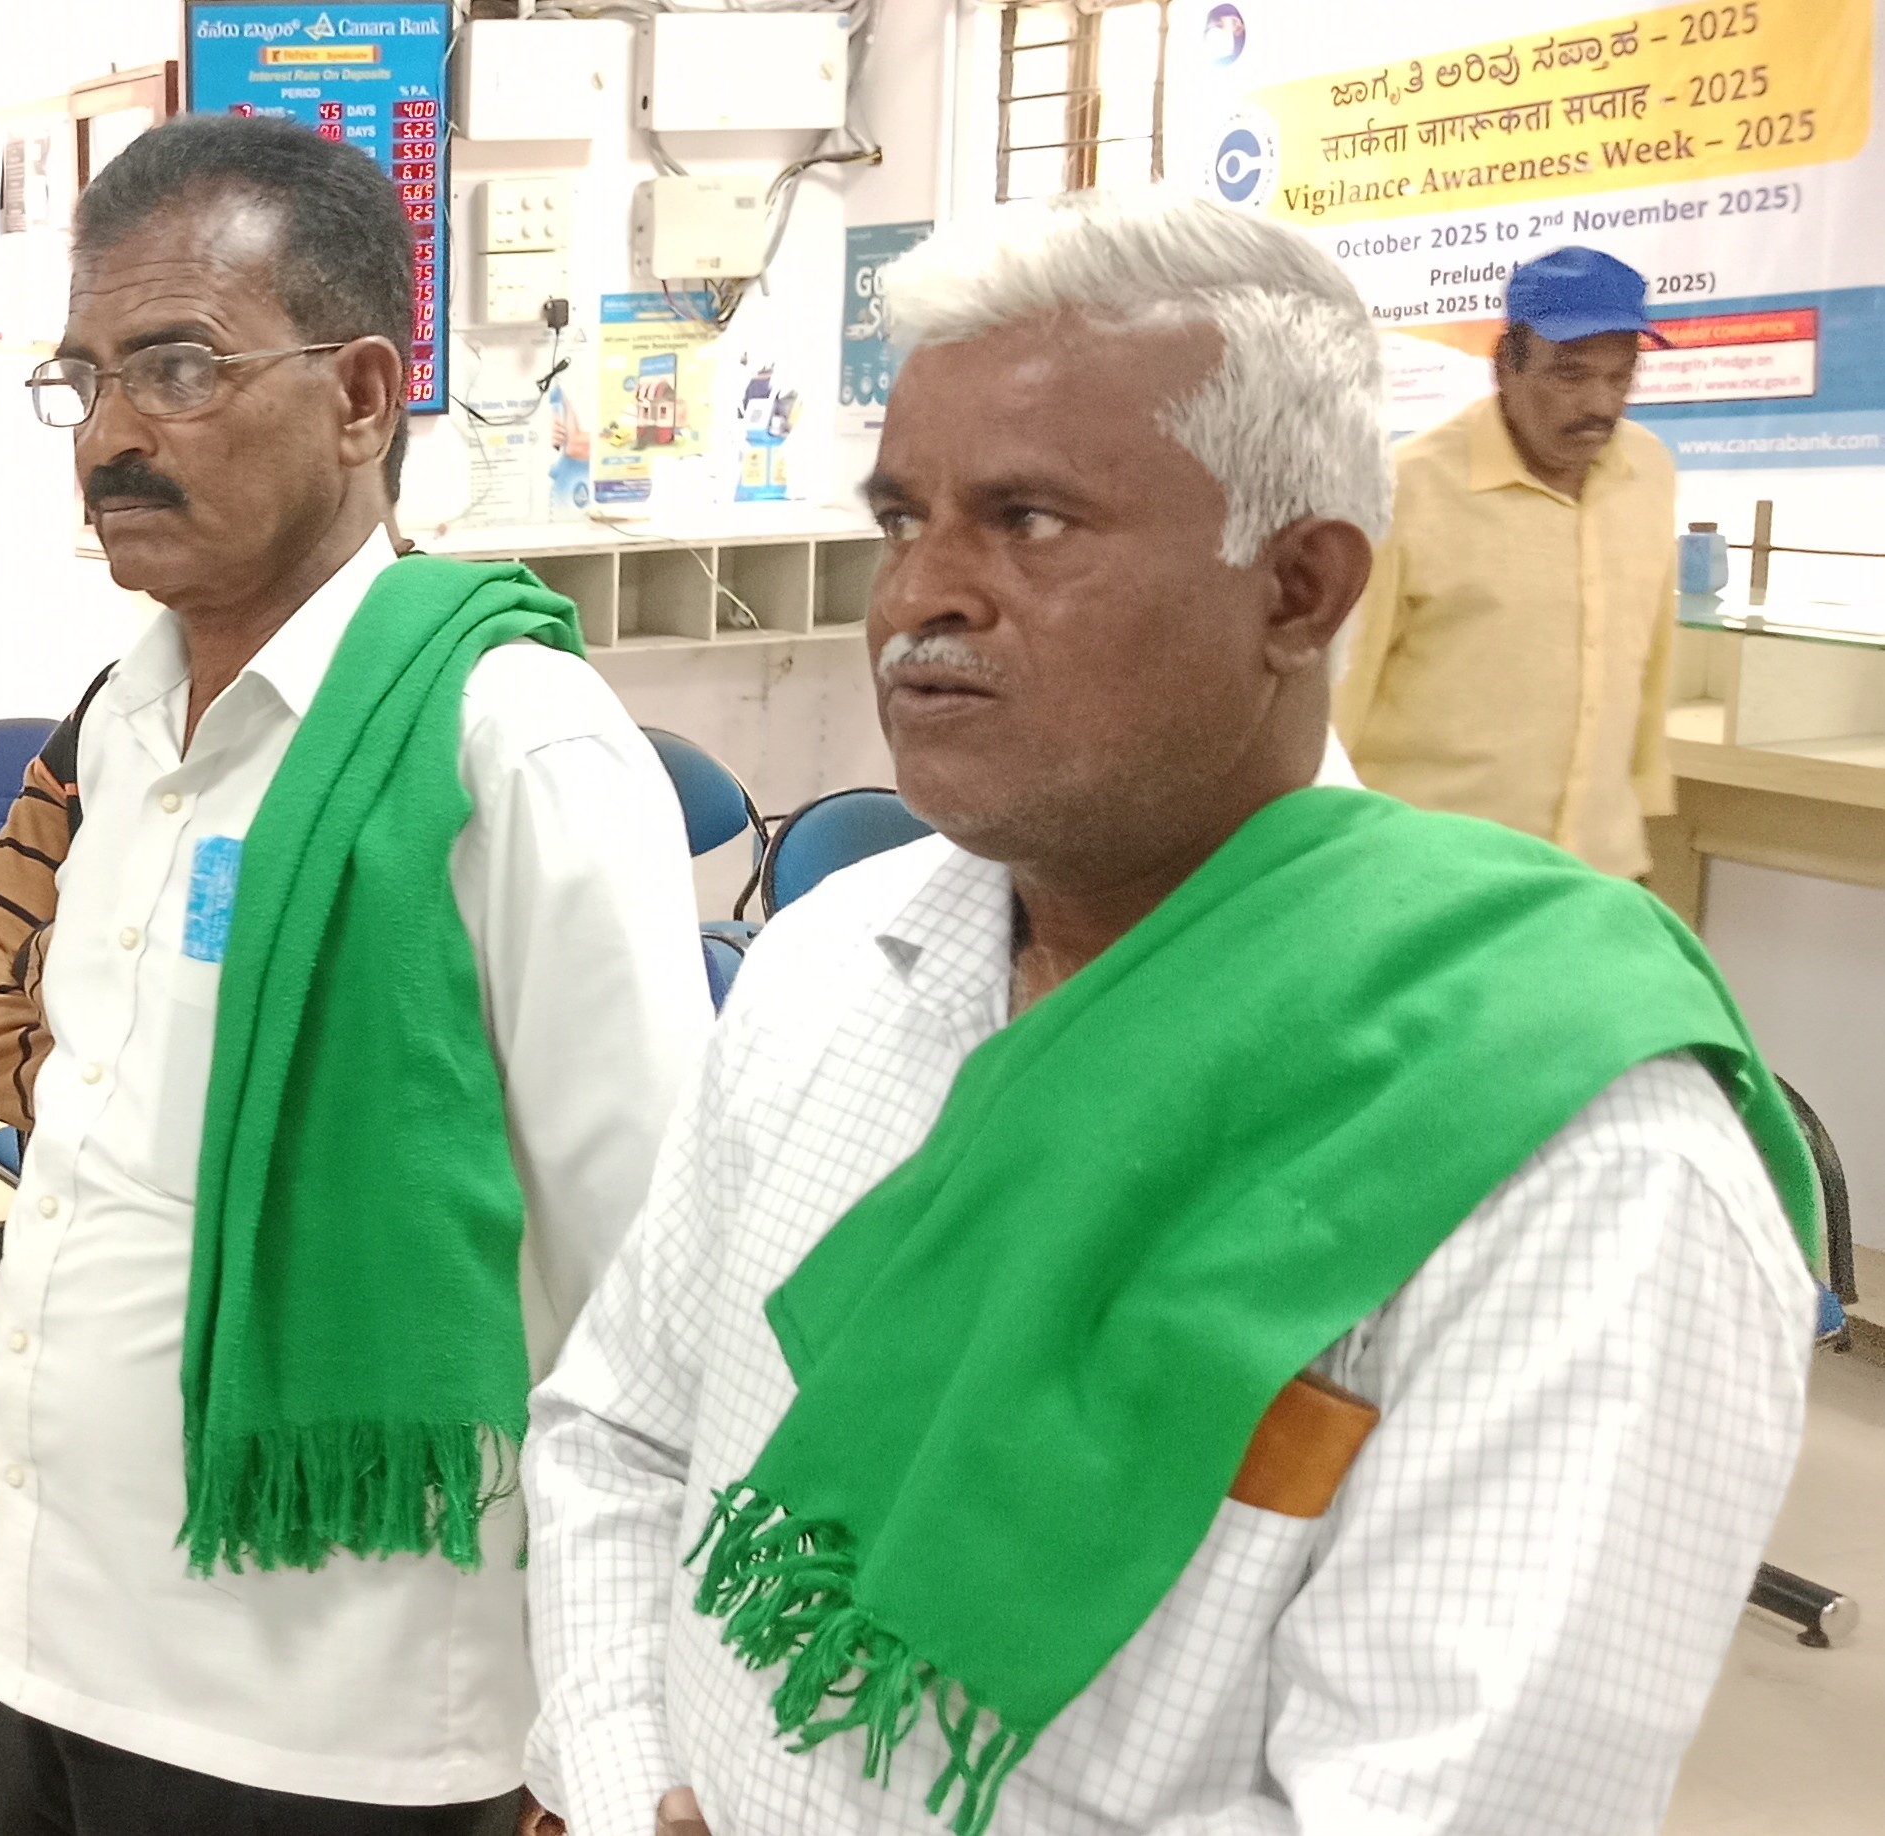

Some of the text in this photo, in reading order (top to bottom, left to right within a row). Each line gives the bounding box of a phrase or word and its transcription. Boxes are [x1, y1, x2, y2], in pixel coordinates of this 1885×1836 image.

[338, 17, 440, 36] Canara Bank
[1436, 45, 1520, 86] ಅರಿವು
[1680, 2, 1760, 46] 2025
[248, 68, 392, 82] Interest Rate On Deposits
[281, 87, 321, 98] PERIOD
[319, 104, 340, 120] 45
[346, 104, 376, 117] DAYS
[1321, 118, 1408, 162] सतर्कता
[1417, 100, 1553, 147] जागरूकता
[1561, 84, 1650, 125] सप्ताह
[1689, 65, 1768, 107] 2025
[346, 125, 376, 137] DAYS
[1283, 176, 1411, 216] Vigilance
[1420, 150, 1588, 195] Awareness
[1601, 129, 1695, 169] Week
[1736, 109, 1816, 151] 2025
[1337, 182, 1801, 259] October 2025 to 2nd November 2025)
[1430, 262, 1506, 286] Prelude
[1372, 272, 1716, 321] August 2025 to 2025)
[1678, 432, 1880, 454] www.canarabank.com
